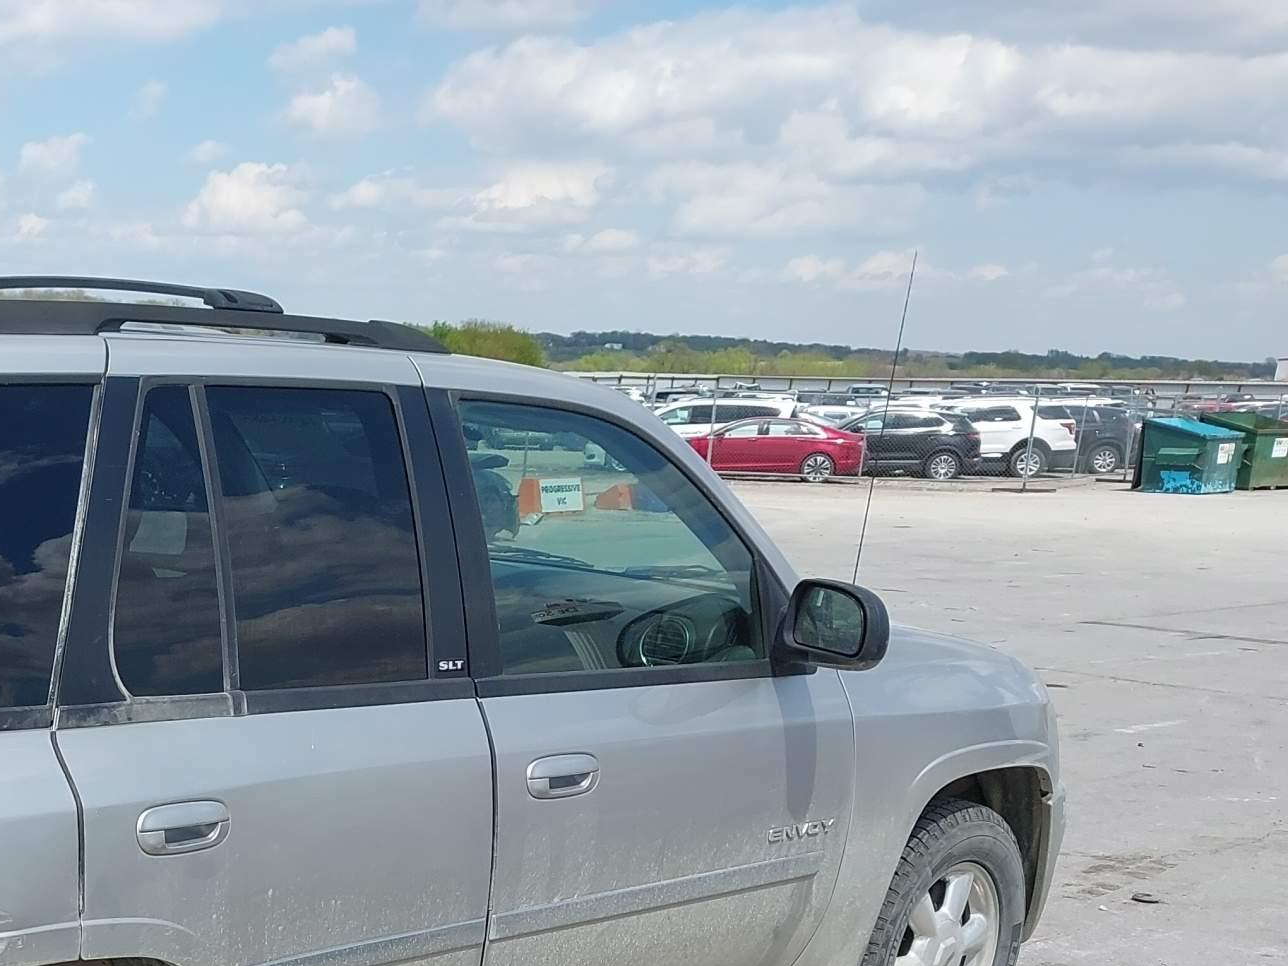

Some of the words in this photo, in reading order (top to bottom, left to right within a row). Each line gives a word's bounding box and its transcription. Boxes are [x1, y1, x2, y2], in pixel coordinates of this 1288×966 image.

[541, 484, 581, 494] PROGRESSIVE
[438, 660, 465, 671] SLT
[767, 817, 836, 844] ENVOY
